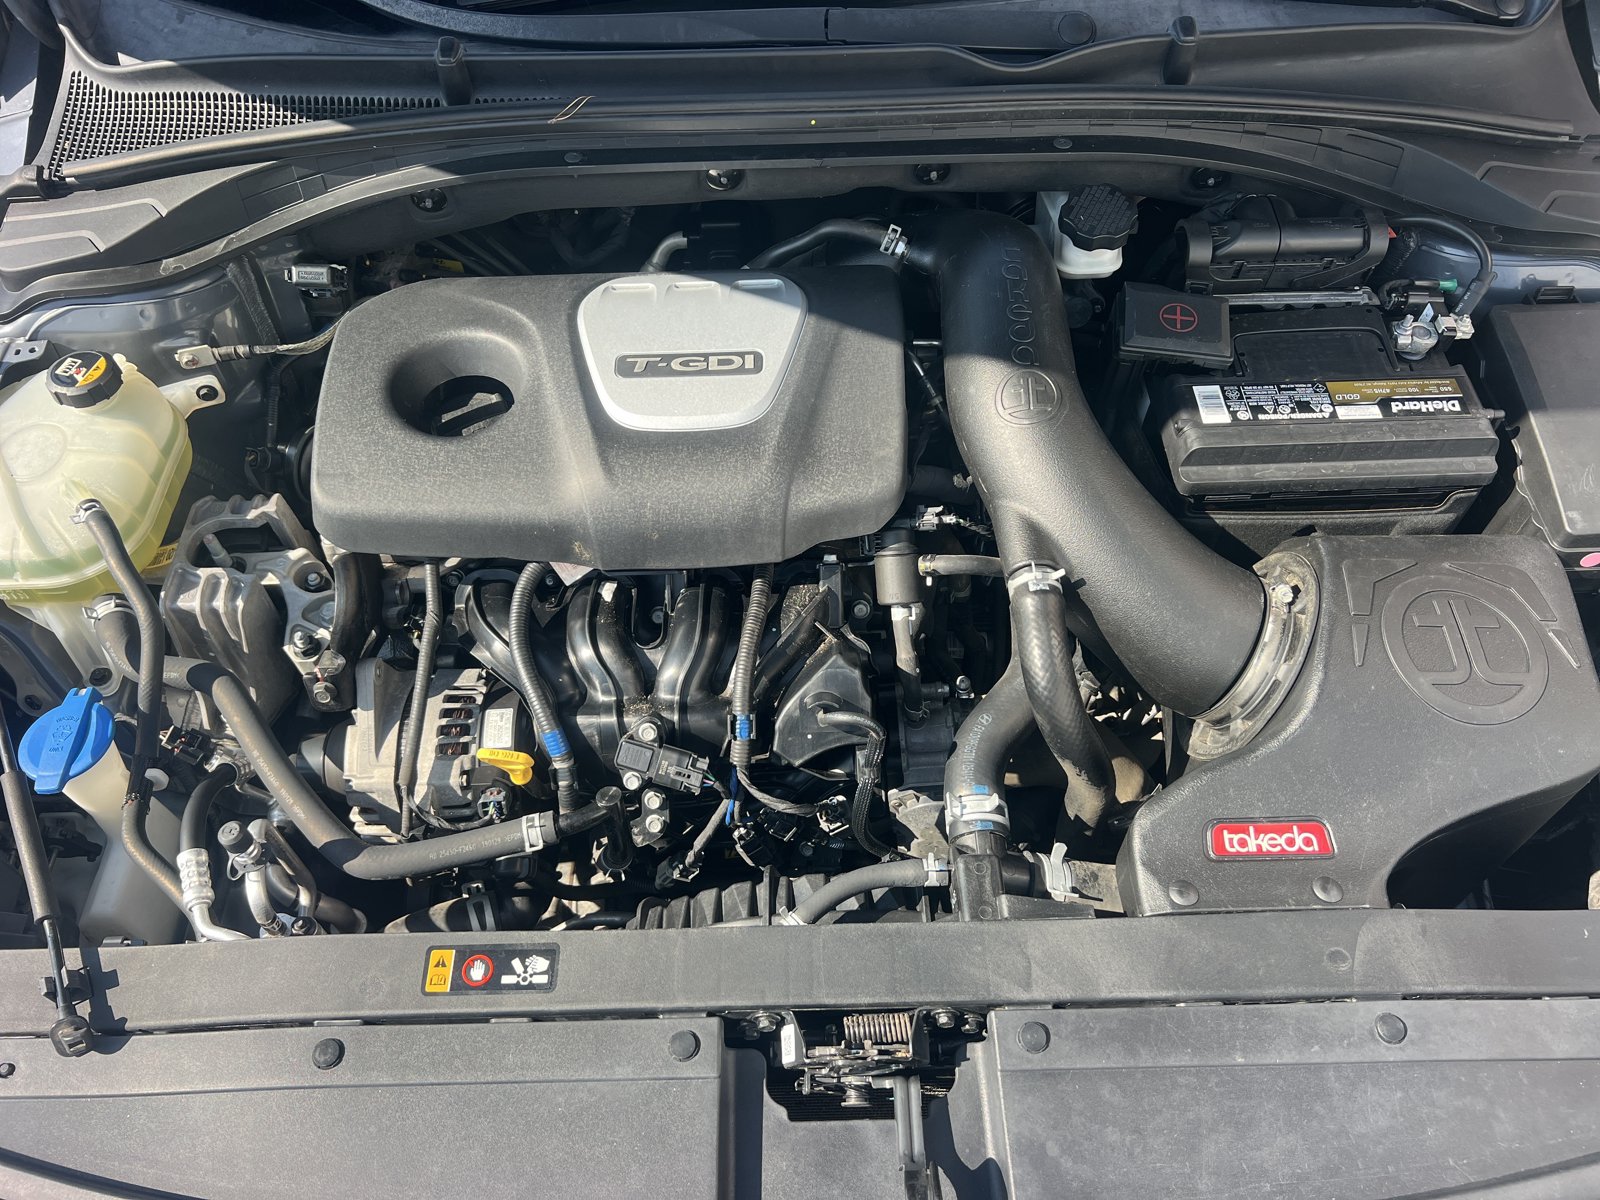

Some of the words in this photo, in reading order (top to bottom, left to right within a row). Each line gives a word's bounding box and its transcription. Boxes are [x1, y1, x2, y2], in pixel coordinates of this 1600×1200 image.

[626, 354, 755, 373] T-GDI
[1391, 400, 1461, 413] DieHard
[1222, 825, 1319, 853] takeda
